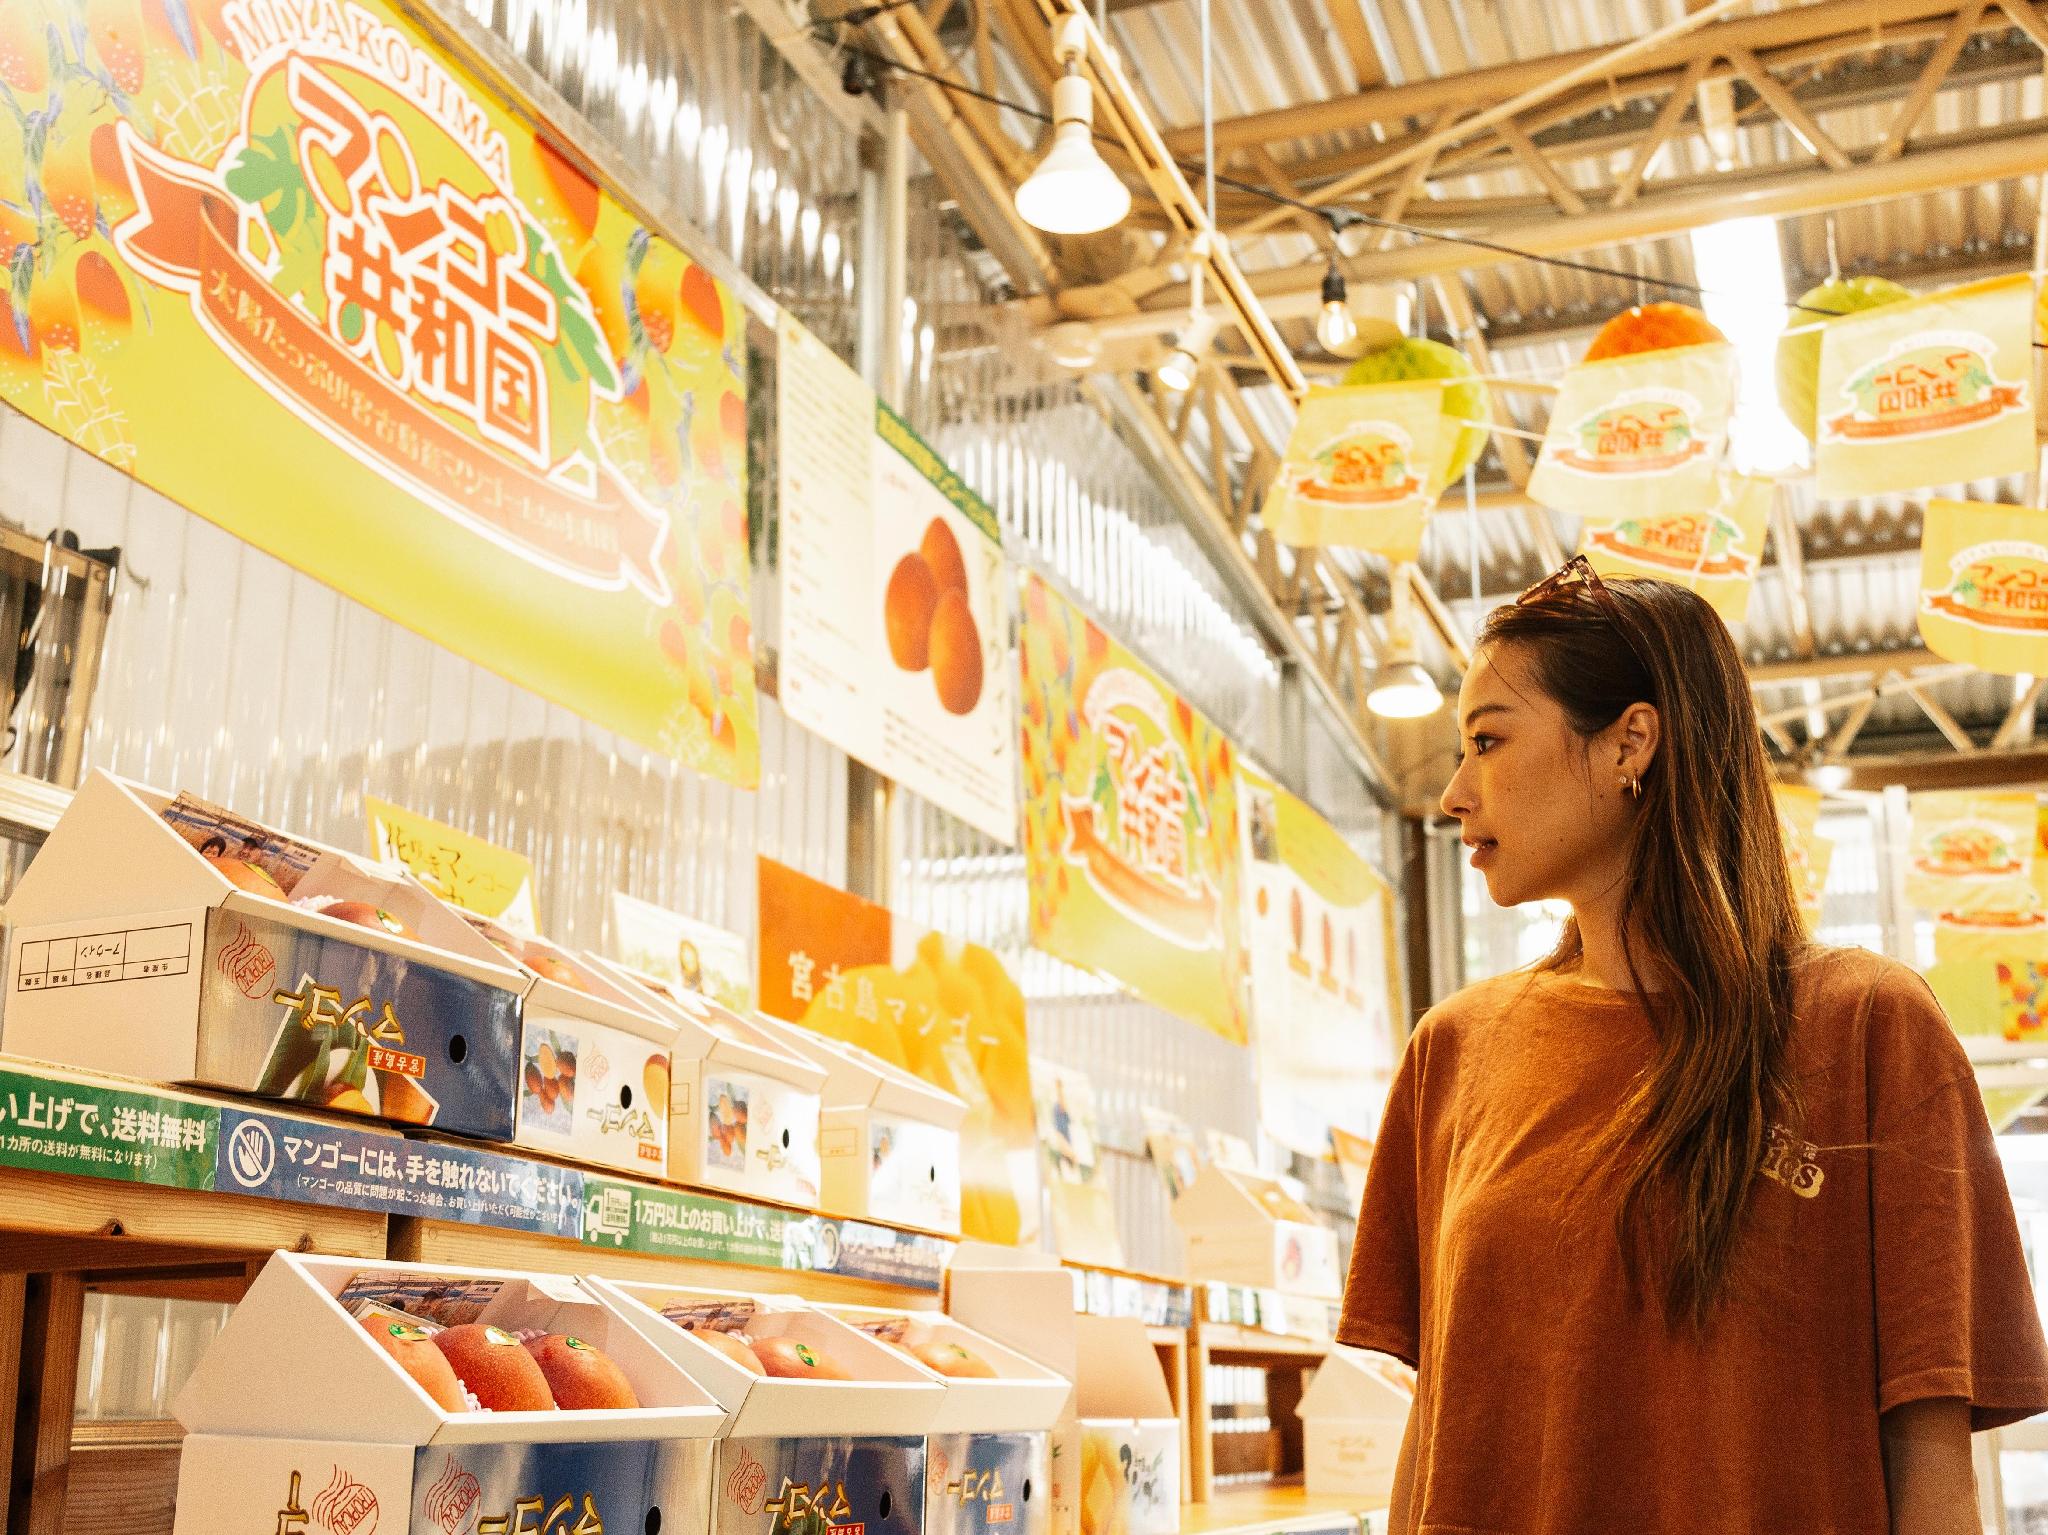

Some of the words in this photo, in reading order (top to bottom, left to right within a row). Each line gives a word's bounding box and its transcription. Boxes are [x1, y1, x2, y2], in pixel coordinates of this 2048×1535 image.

[224, 0, 508, 180] MIYAKOJIMA
[333, 220, 547, 458] 共和国
[79, 942, 120, 958] アーウィン
[272, 983, 405, 1045] マンゴー
[373, 1050, 421, 1074] 宮古島産
[283, 1135, 578, 1209] マンゴーには、手を触れないでください。
[764, 1481, 851, 1528] マンゴー
